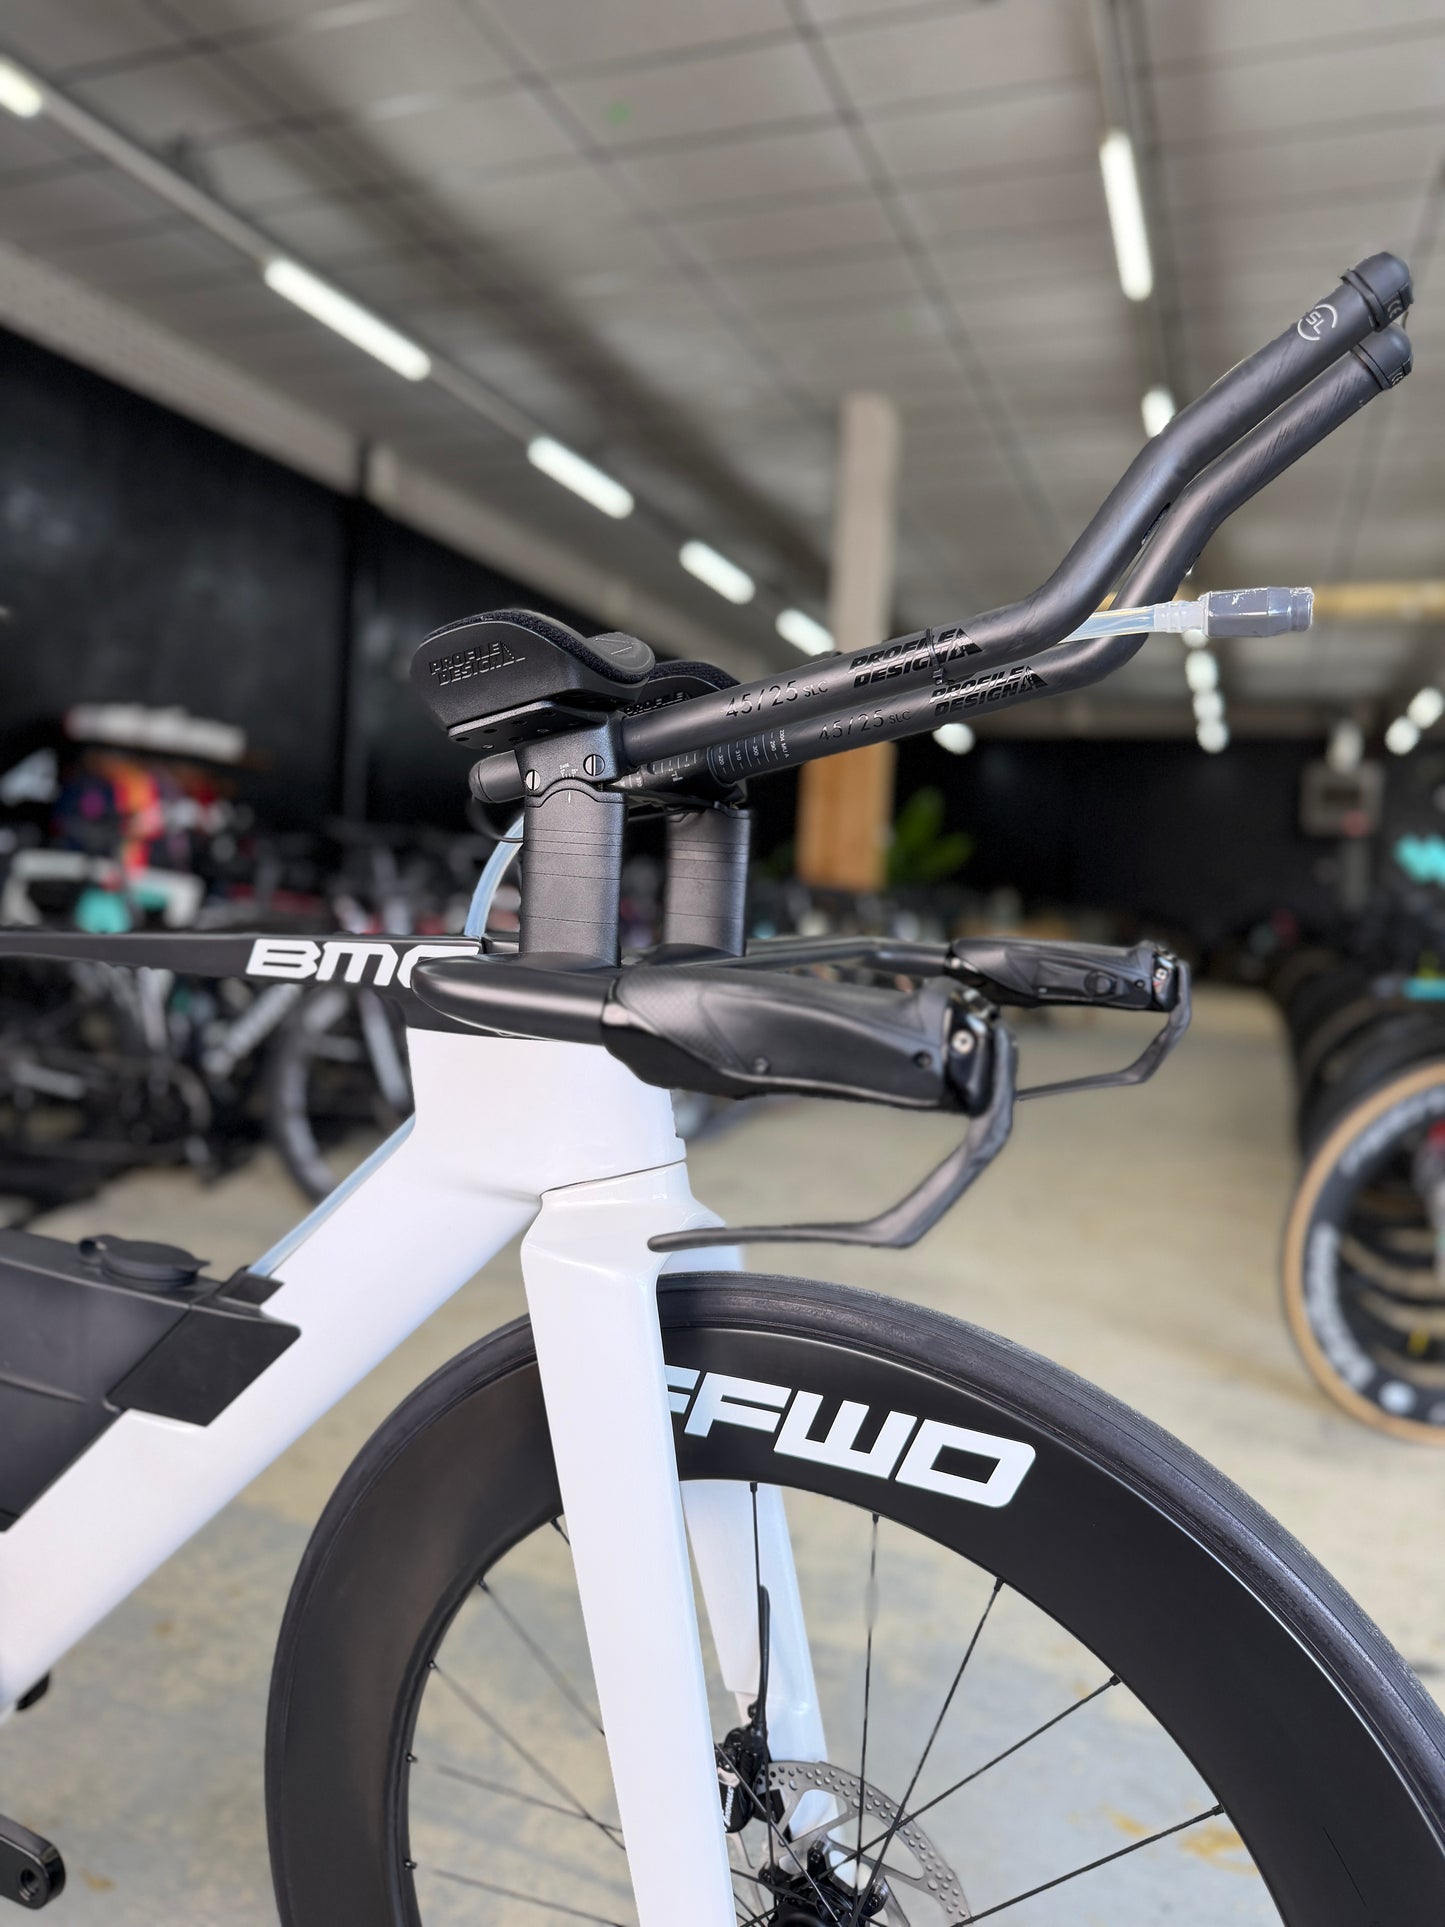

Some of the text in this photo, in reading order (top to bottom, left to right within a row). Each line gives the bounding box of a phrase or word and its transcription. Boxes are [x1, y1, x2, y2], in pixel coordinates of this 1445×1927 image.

[1306, 311, 1326, 335] SL
[429, 642, 501, 676] PROFILE
[439, 655, 502, 687] DESIGN
[725, 680, 829, 718] 45/25 SLC
[929, 665, 1025, 704] PROFILE
[934, 681, 1021, 717] DESIGN
[818, 709, 912, 742] 45/25 SLC
